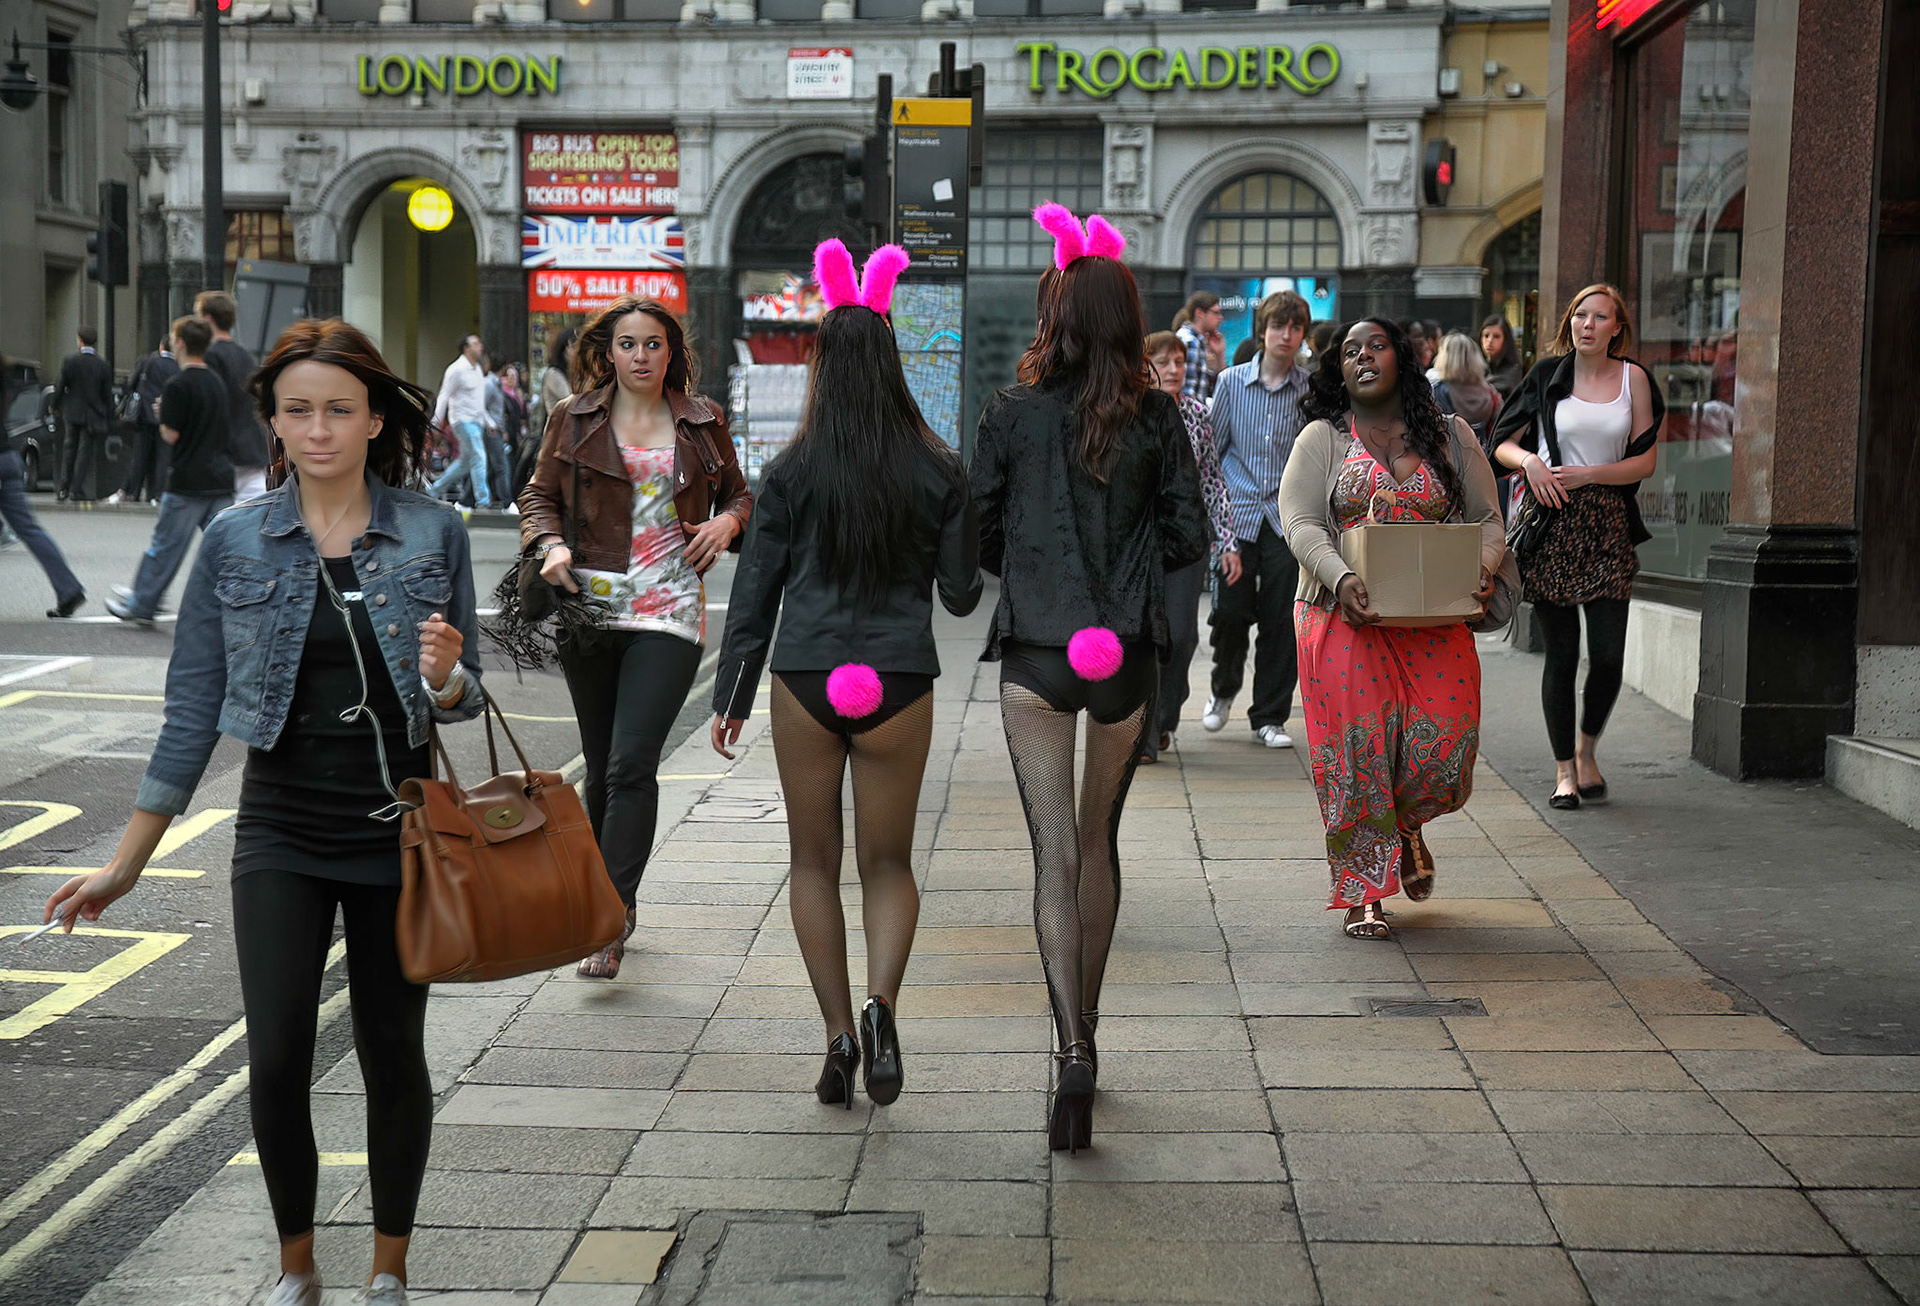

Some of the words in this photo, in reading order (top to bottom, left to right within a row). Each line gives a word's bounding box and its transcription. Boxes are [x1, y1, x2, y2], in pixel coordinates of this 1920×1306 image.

[358, 54, 560, 96] LONDON
[1016, 42, 1342, 97] TROCADERO
[532, 135, 559, 151] BIG
[563, 135, 593, 151] BUS
[528, 152, 626, 170] SIGHTSEEING
[629, 152, 679, 170] TOURS
[526, 187, 579, 206] TICKETS
[581, 187, 607, 206] ON
[609, 187, 643, 206] SALE
[543, 223, 662, 244] IMPERIAL
[536, 273, 581, 297] 50%
[585, 276, 627, 294] SALE
[633, 273, 679, 298] 50%
[1698, 490, 1725, 525] ANGUS
